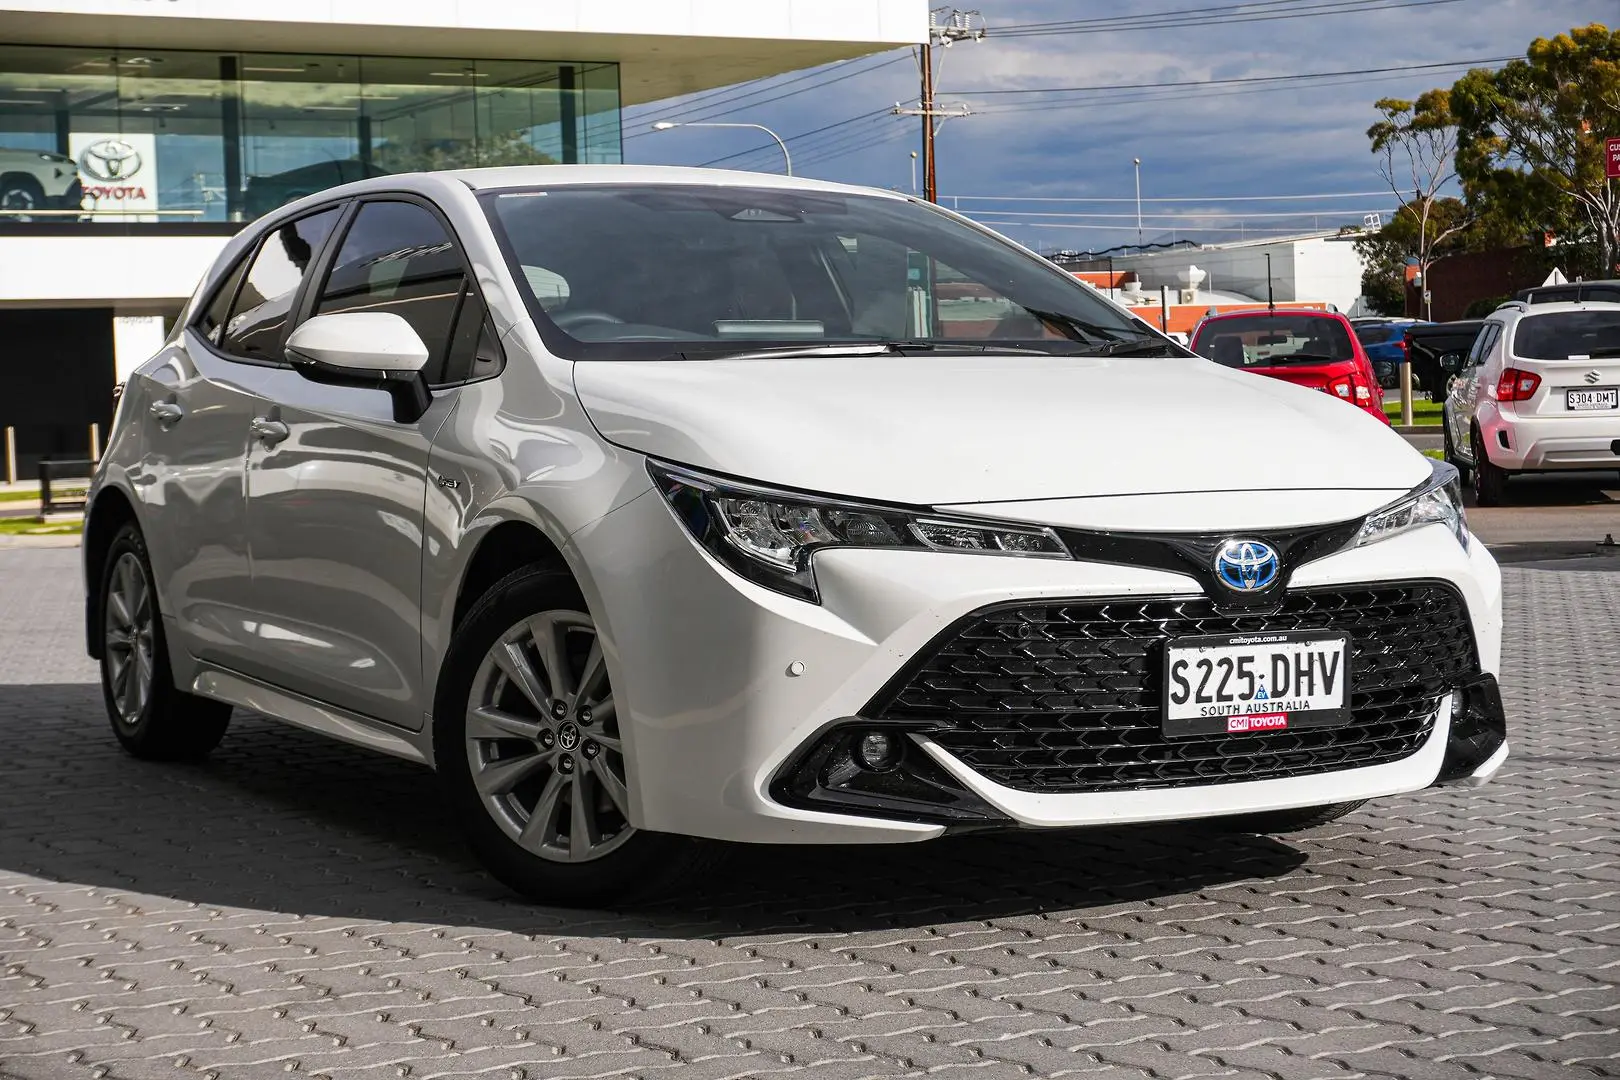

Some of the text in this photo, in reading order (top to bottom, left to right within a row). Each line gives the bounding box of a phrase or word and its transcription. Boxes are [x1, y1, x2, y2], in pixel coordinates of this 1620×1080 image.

[1229, 635, 1287, 645] cmitoyota.com.au
[1257, 691, 1267, 699] EV
[1201, 700, 1311, 717] SOUTH AUSTRALIA
[1249, 715, 1287, 727] TOYOTA
